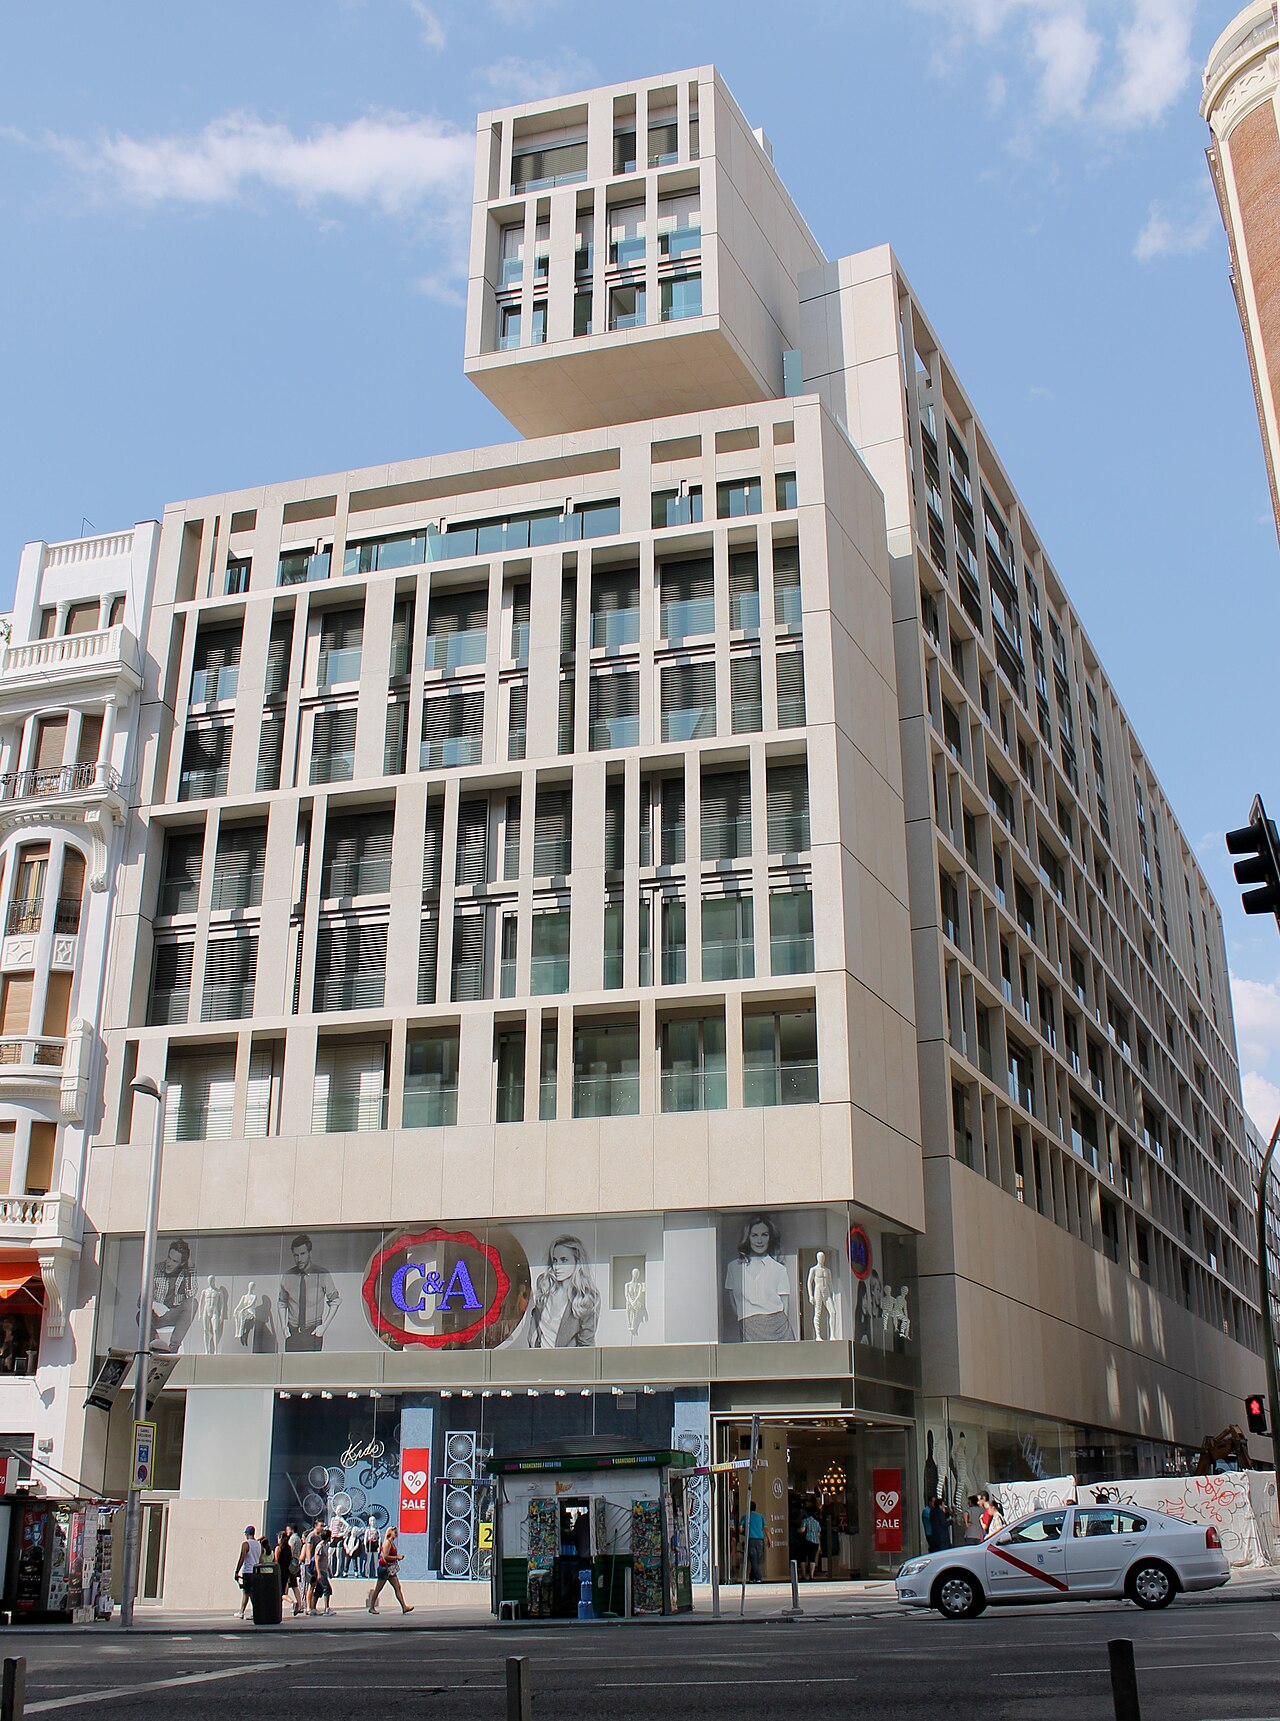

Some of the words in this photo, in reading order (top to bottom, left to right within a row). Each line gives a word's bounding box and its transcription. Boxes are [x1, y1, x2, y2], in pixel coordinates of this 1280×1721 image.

[390, 1259, 484, 1312] C&A
[340, 1438, 385, 1469] Kids
[401, 1499, 426, 1509] SALE
[876, 1519, 900, 1528] SALE
